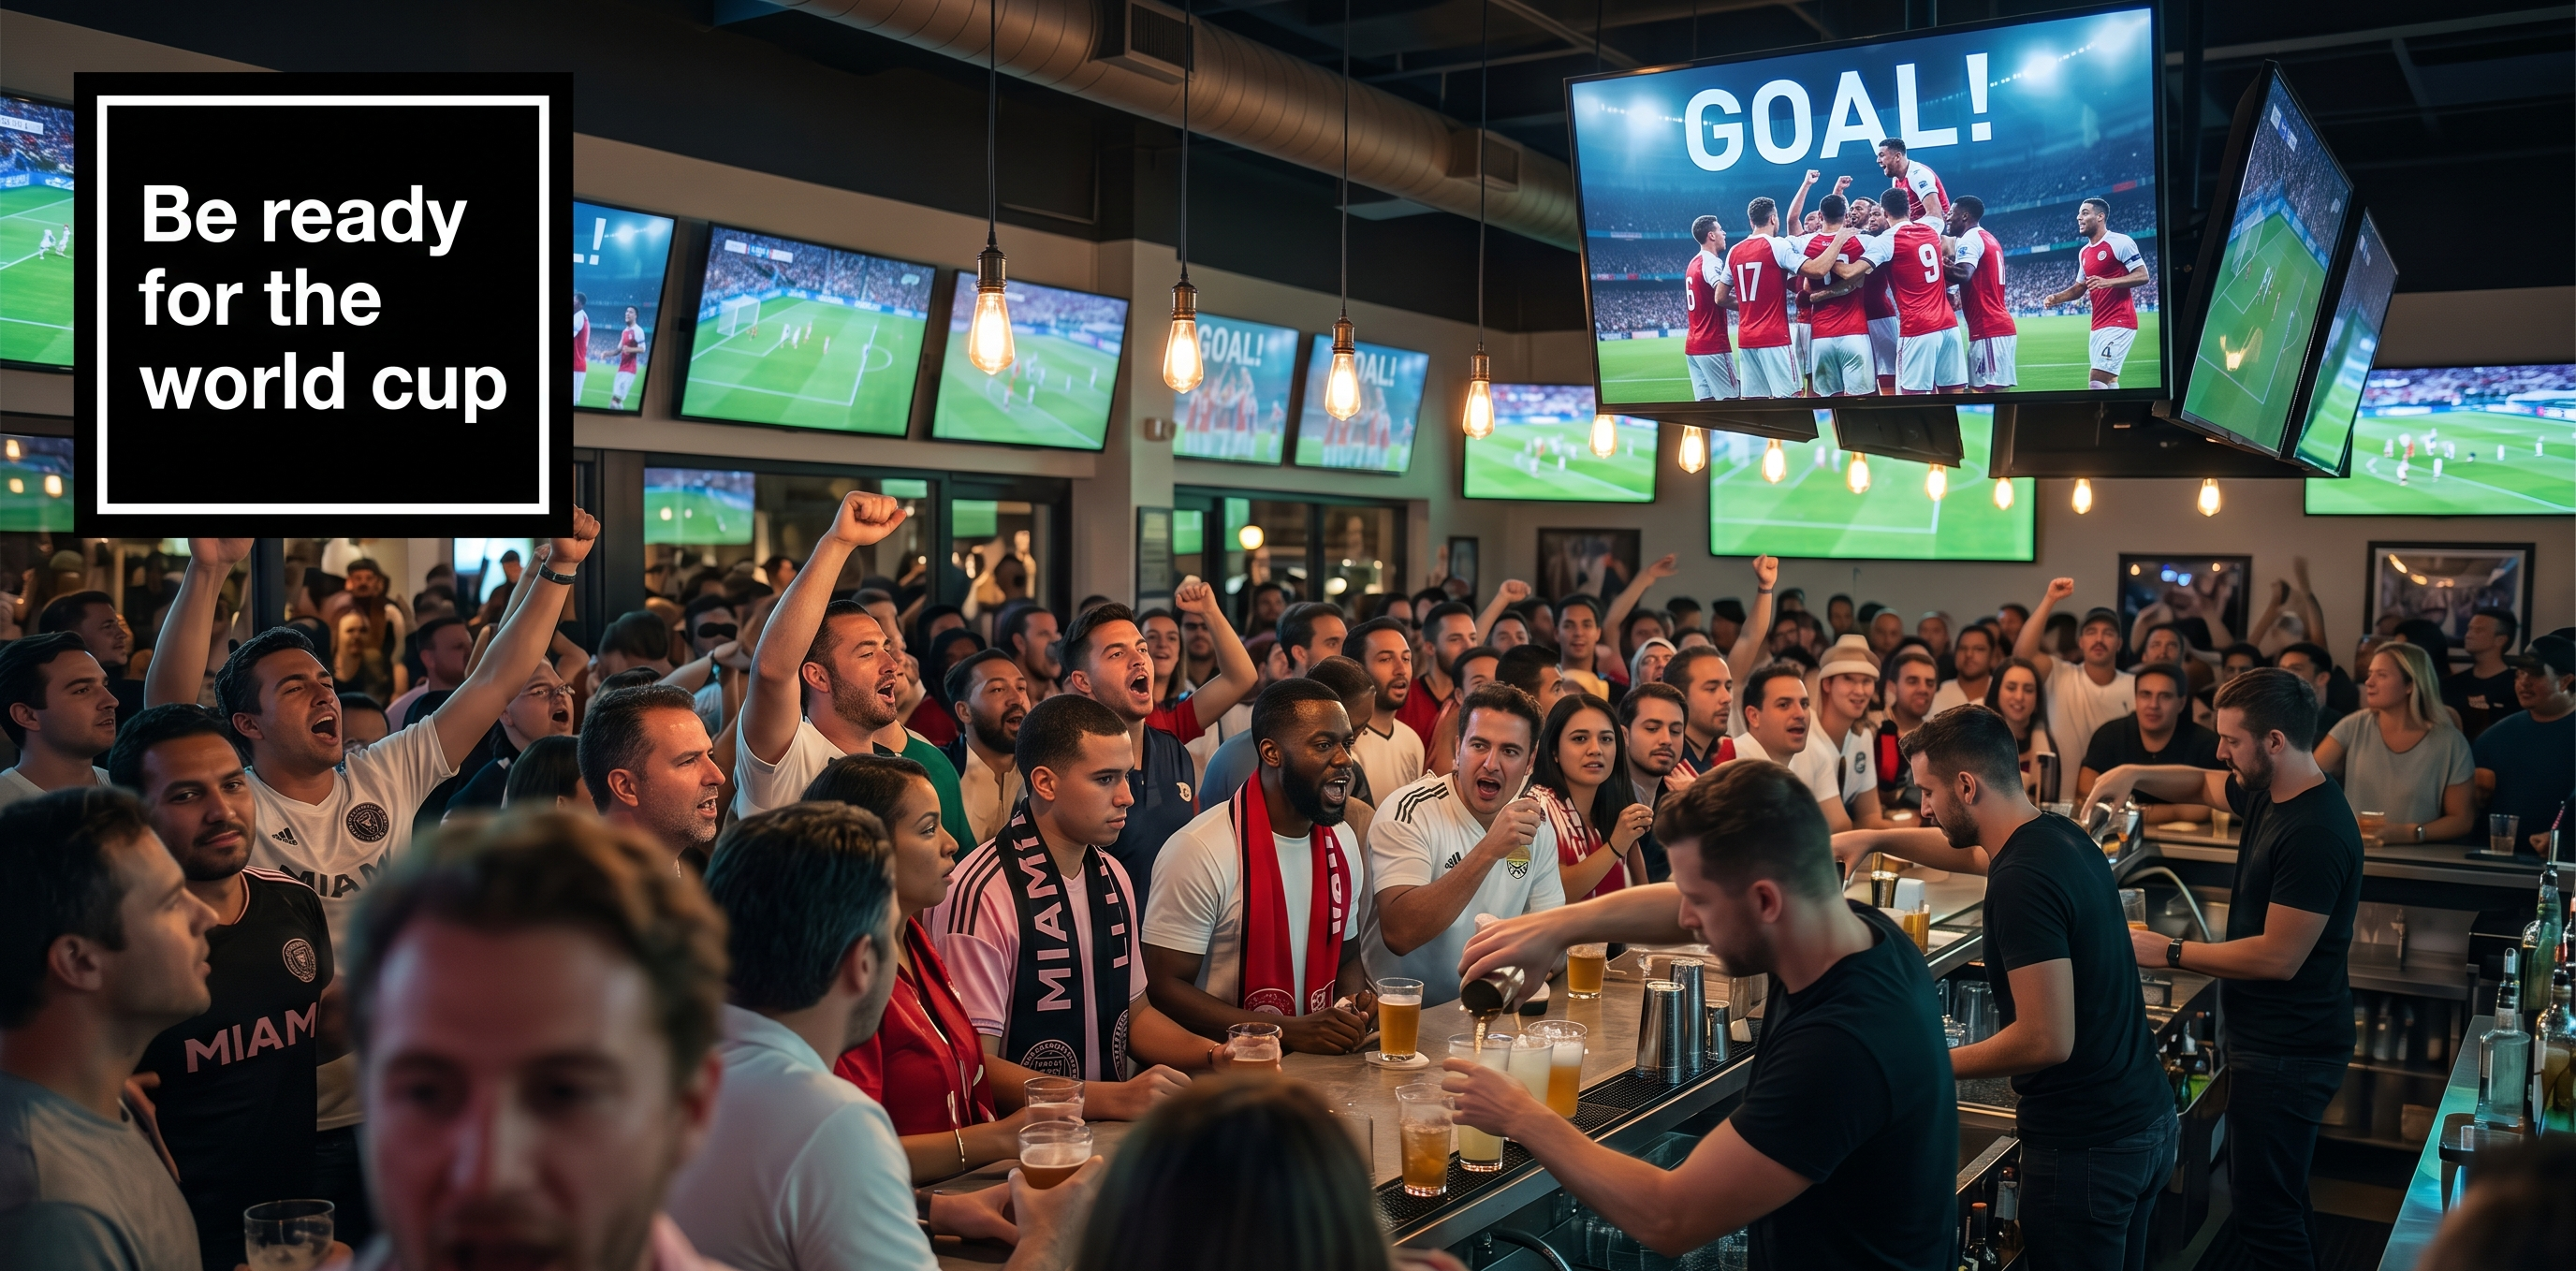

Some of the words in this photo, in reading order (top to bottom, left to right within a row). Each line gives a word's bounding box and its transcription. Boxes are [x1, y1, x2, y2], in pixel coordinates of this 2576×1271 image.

[1685, 52, 1992, 171] GOAL!
[1736, 262, 1763, 302] 17
[1919, 243, 1940, 284] 9
[1686, 276, 1696, 312] 6
[1198, 324, 1265, 367] GOAL!
[1354, 350, 1398, 387] OAL!
[279, 849, 391, 898] MIAM
[184, 1001, 316, 1074] MIAM
